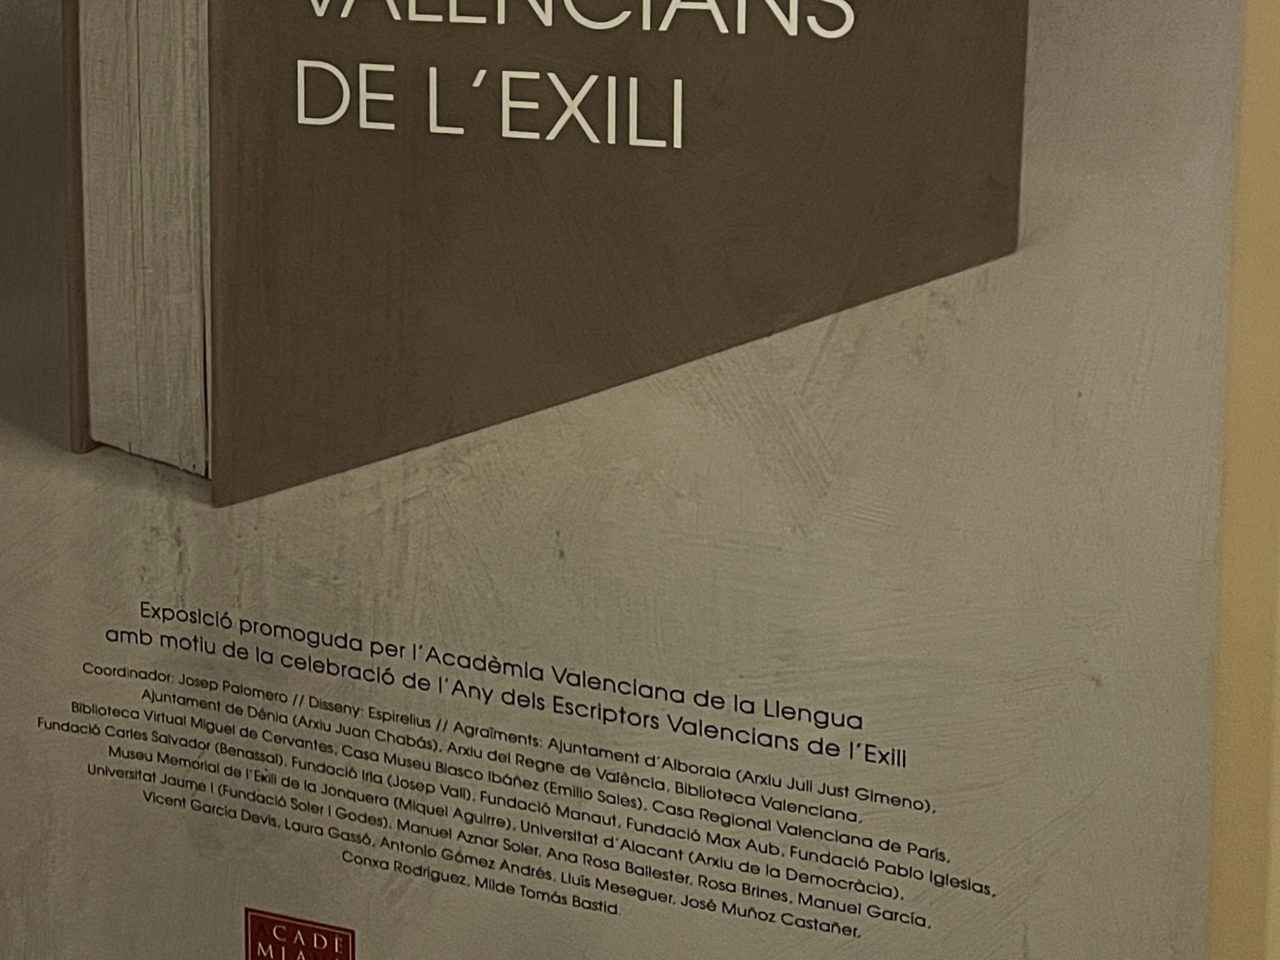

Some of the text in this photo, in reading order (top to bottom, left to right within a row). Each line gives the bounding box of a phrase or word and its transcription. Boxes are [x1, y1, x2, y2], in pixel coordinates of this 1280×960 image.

[296, 59, 683, 150] DE L'EXILI
[104, 627, 907, 769] amb motiu de la celebració de l'Any dels Escriptors Valencians de l'Exili
[139, 600, 863, 731] Exposició promoguda per l'Acadèmia Valenciana de la Llengua
[36, 715, 102, 737] Fundació
[103, 724, 149, 742] Carles
[150, 729, 212, 752] Salvador
[290, 754, 358, 780] Fundació
[479, 789, 552, 816] Fundació
[625, 815, 702, 843] Fundació
[705, 830, 741, 850] Max
[788, 844, 870, 871] Fundació
[873, 858, 925, 881] Pablo
[70, 700, 140, 720] Biblioteca
[142, 708, 187, 727] Virtual
[189, 715, 236, 736] Miguel
[238, 725, 259, 741] de
[340, 743, 380, 763] Casa
[382, 750, 432, 772] Museu
[434, 759, 484, 781] Blasco
[486, 769, 540, 792] Ibáñez
[651, 798, 695, 820] Casa
[698, 806, 772, 832] Regional
[775, 819, 874, 849] Valenciana
[877, 837, 902, 854] de
[140, 687, 221, 713] Ajuntament
[224, 702, 244, 717] de
[246, 704, 289, 725] Dénia
[334, 721, 371, 740] Juan
[445, 740, 483, 760] Arxiu
[486, 748, 511, 764] del
[514, 752, 566, 774] Regne
[569, 763, 592, 779] de
[674, 780, 757, 807] Biblioteca
[177, 672, 219, 692] Josep
[221, 678, 289, 704] Palomero
[367, 705, 432, 729] Espirelius
[546, 736, 640, 765] Ajuntament
[785, 776, 813, 793] Juli
[816, 781, 850, 799] Just
[86, 762, 157, 784] Universitat
[159, 772, 207, 793] Jaume
[289, 796, 325, 816] Soler
[396, 817, 453, 840] Manuel
[455, 829, 499, 849] Aznar
[545, 846, 579, 864] Ana
[581, 851, 621, 872] Rosa
[697, 873, 737, 894] Rosa
[797, 891, 862, 916] Manuel
[107, 744, 154, 763] Museu
[156, 750, 220, 774] Memorial
[222, 764, 242, 779] de
[279, 775, 301, 790] de
[302, 778, 317, 794] la
[319, 782, 390, 808] Jonquera
[519, 818, 599, 846] Universitat
[737, 859, 761, 876] de
[764, 862, 781, 879] la
[141, 788, 187, 809] Vicent
[283, 816, 324, 837] Laura
[378, 835, 437, 859] Antonio
[440, 846, 496, 871] Gómez
[679, 893, 718, 913] José
[720, 900, 777, 924] Muñoz
[340, 848, 390, 871] Conxa
[519, 883, 568, 906] Tomás
